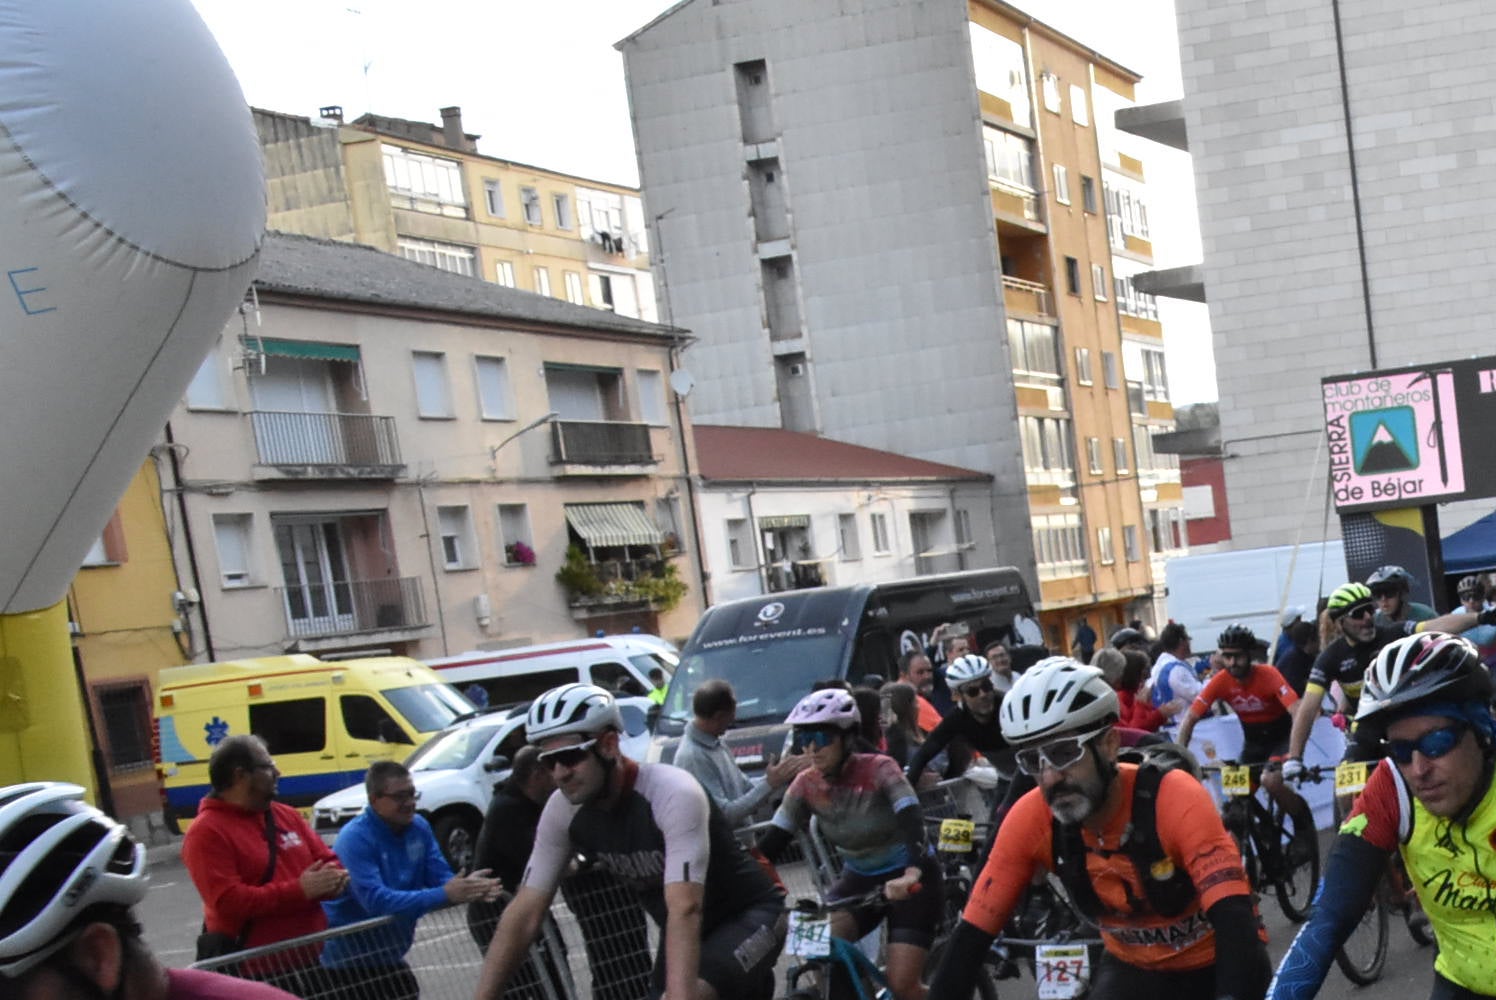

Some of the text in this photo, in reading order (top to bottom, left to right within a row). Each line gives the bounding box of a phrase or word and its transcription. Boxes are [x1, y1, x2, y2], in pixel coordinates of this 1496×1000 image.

[1323, 378, 1391, 399] club de
[1326, 389, 1432, 413] montañeros
[1327, 414, 1352, 484] SIERRA
[1335, 477, 1424, 502] de Béjar
[703, 626, 826, 650] www.forevent.es
[1041, 959, 1084, 982] 127
